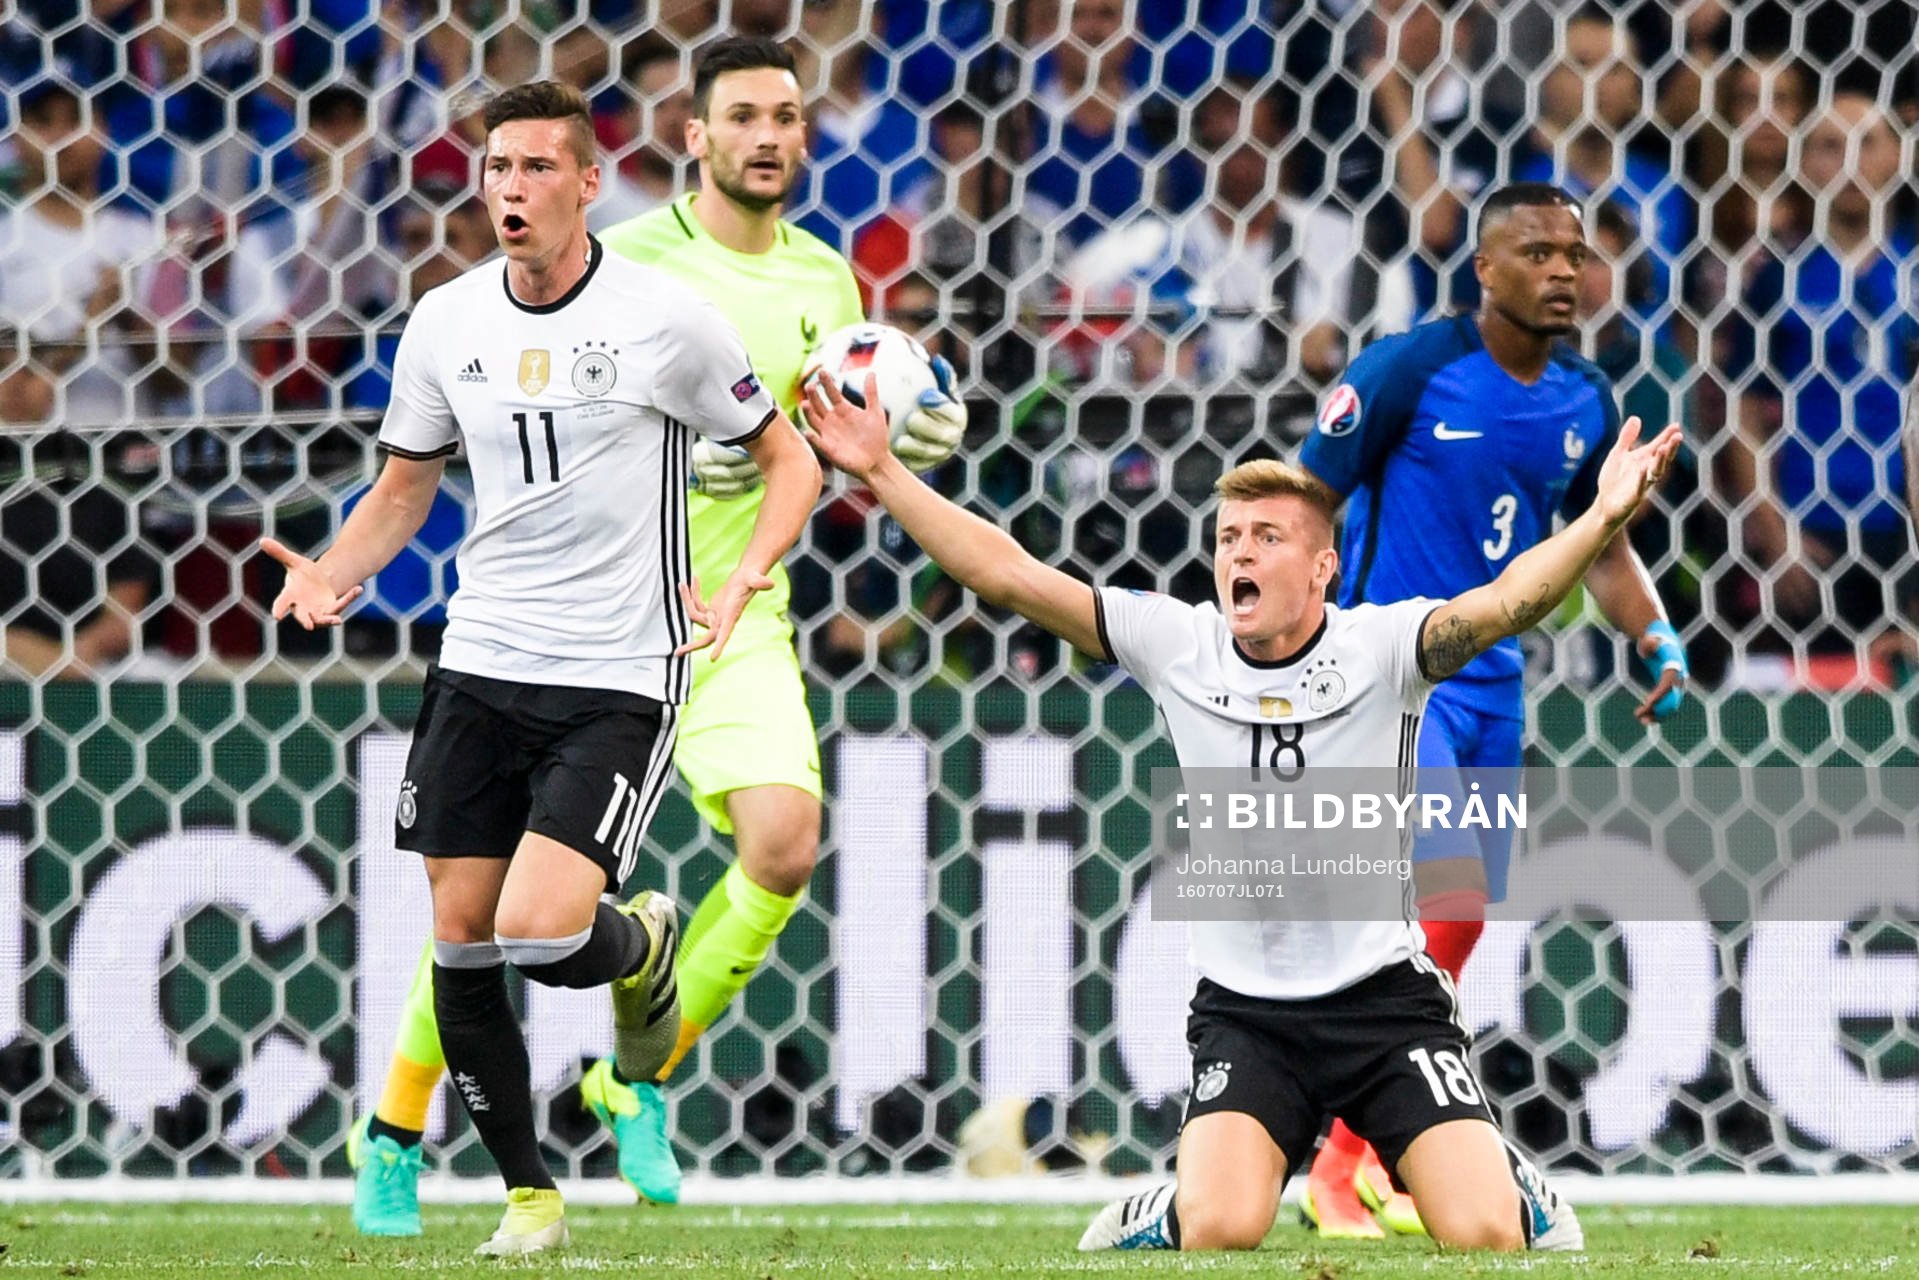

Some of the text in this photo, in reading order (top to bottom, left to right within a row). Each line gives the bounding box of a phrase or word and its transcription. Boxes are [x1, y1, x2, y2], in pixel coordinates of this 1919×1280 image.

[457, 374, 488, 383] adidas
[512, 412, 560, 484] 11
[1483, 494, 1517, 561] 3
[1250, 723, 1306, 783] 18
[594, 772, 638, 857] 11
[1408, 1048, 1480, 1107] 18
